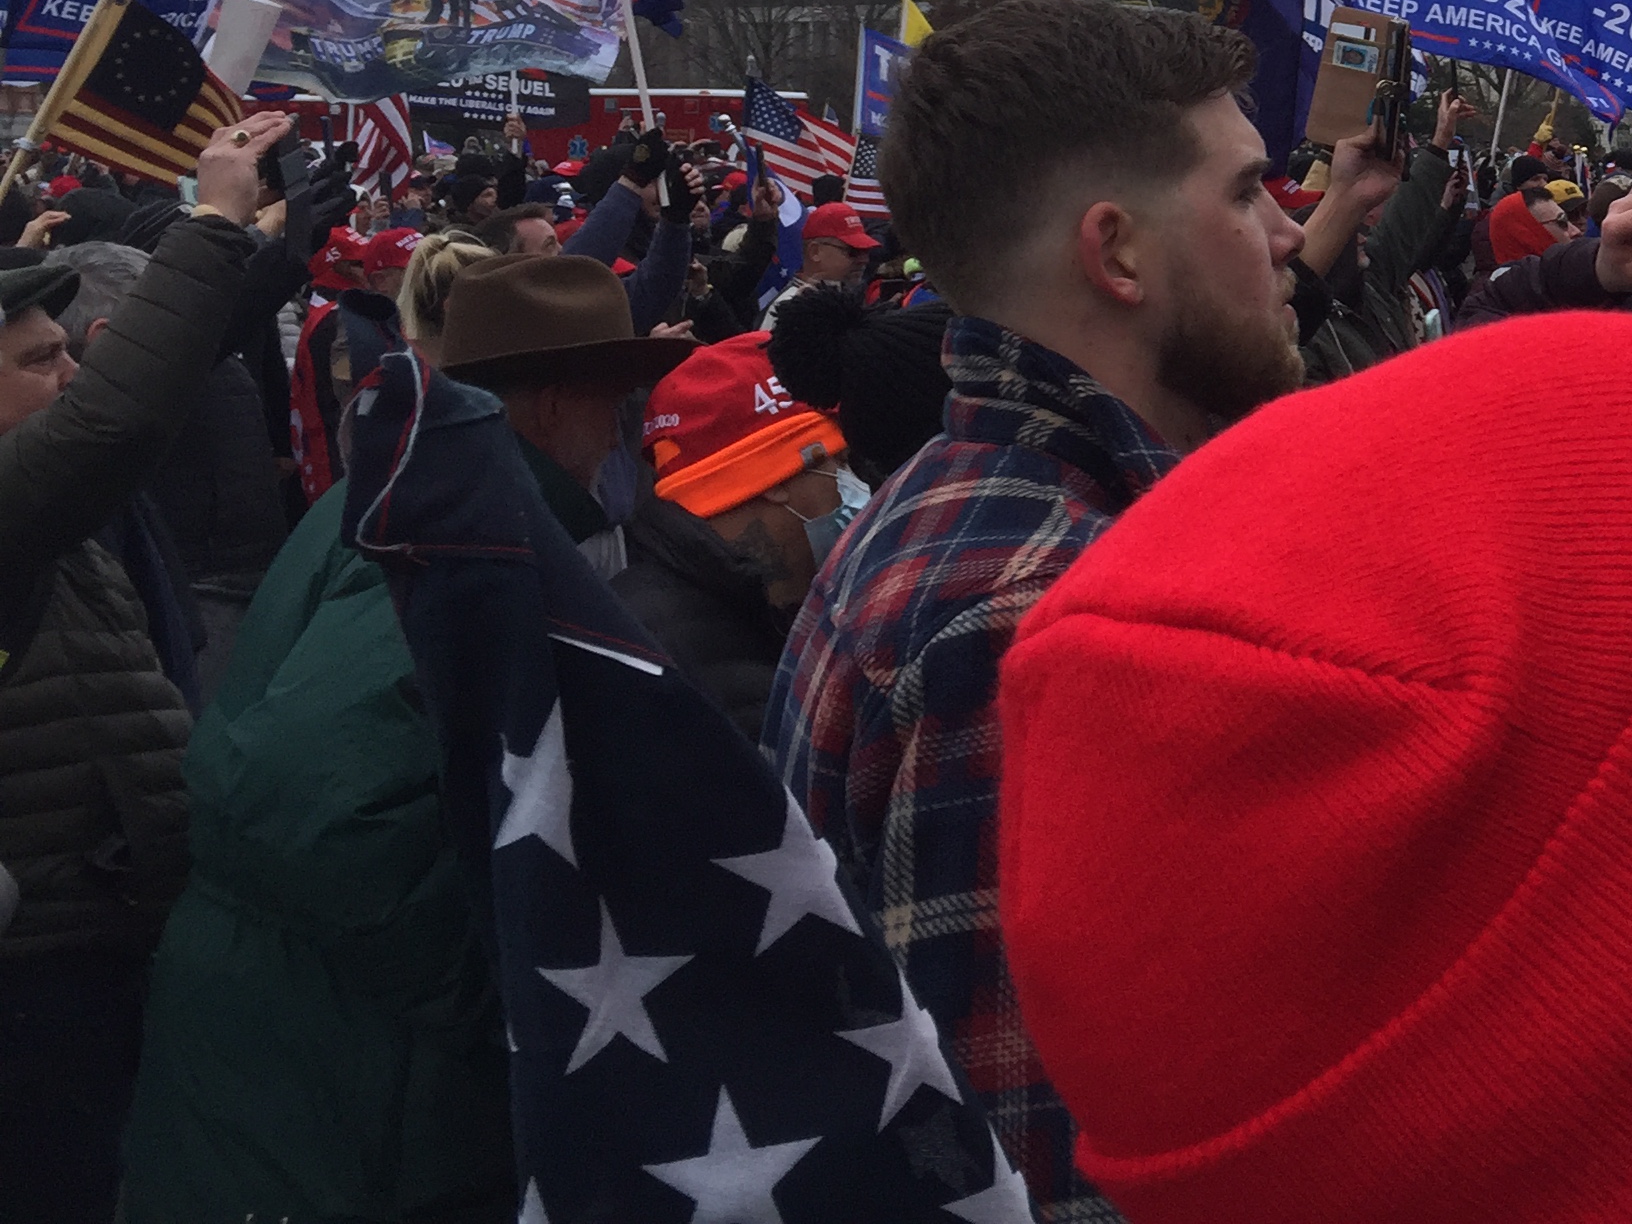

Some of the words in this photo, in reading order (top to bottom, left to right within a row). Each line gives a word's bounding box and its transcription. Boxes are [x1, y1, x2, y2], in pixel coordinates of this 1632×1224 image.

[467, 24, 536, 45] TRUMP
[1423, 2, 1545, 55] AMERICA
[1541, 16, 1584, 46] KEE
[408, 93, 437, 106] MAKE
[438, 96, 457, 107] THE
[459, 98, 504, 112] LIBERALS
